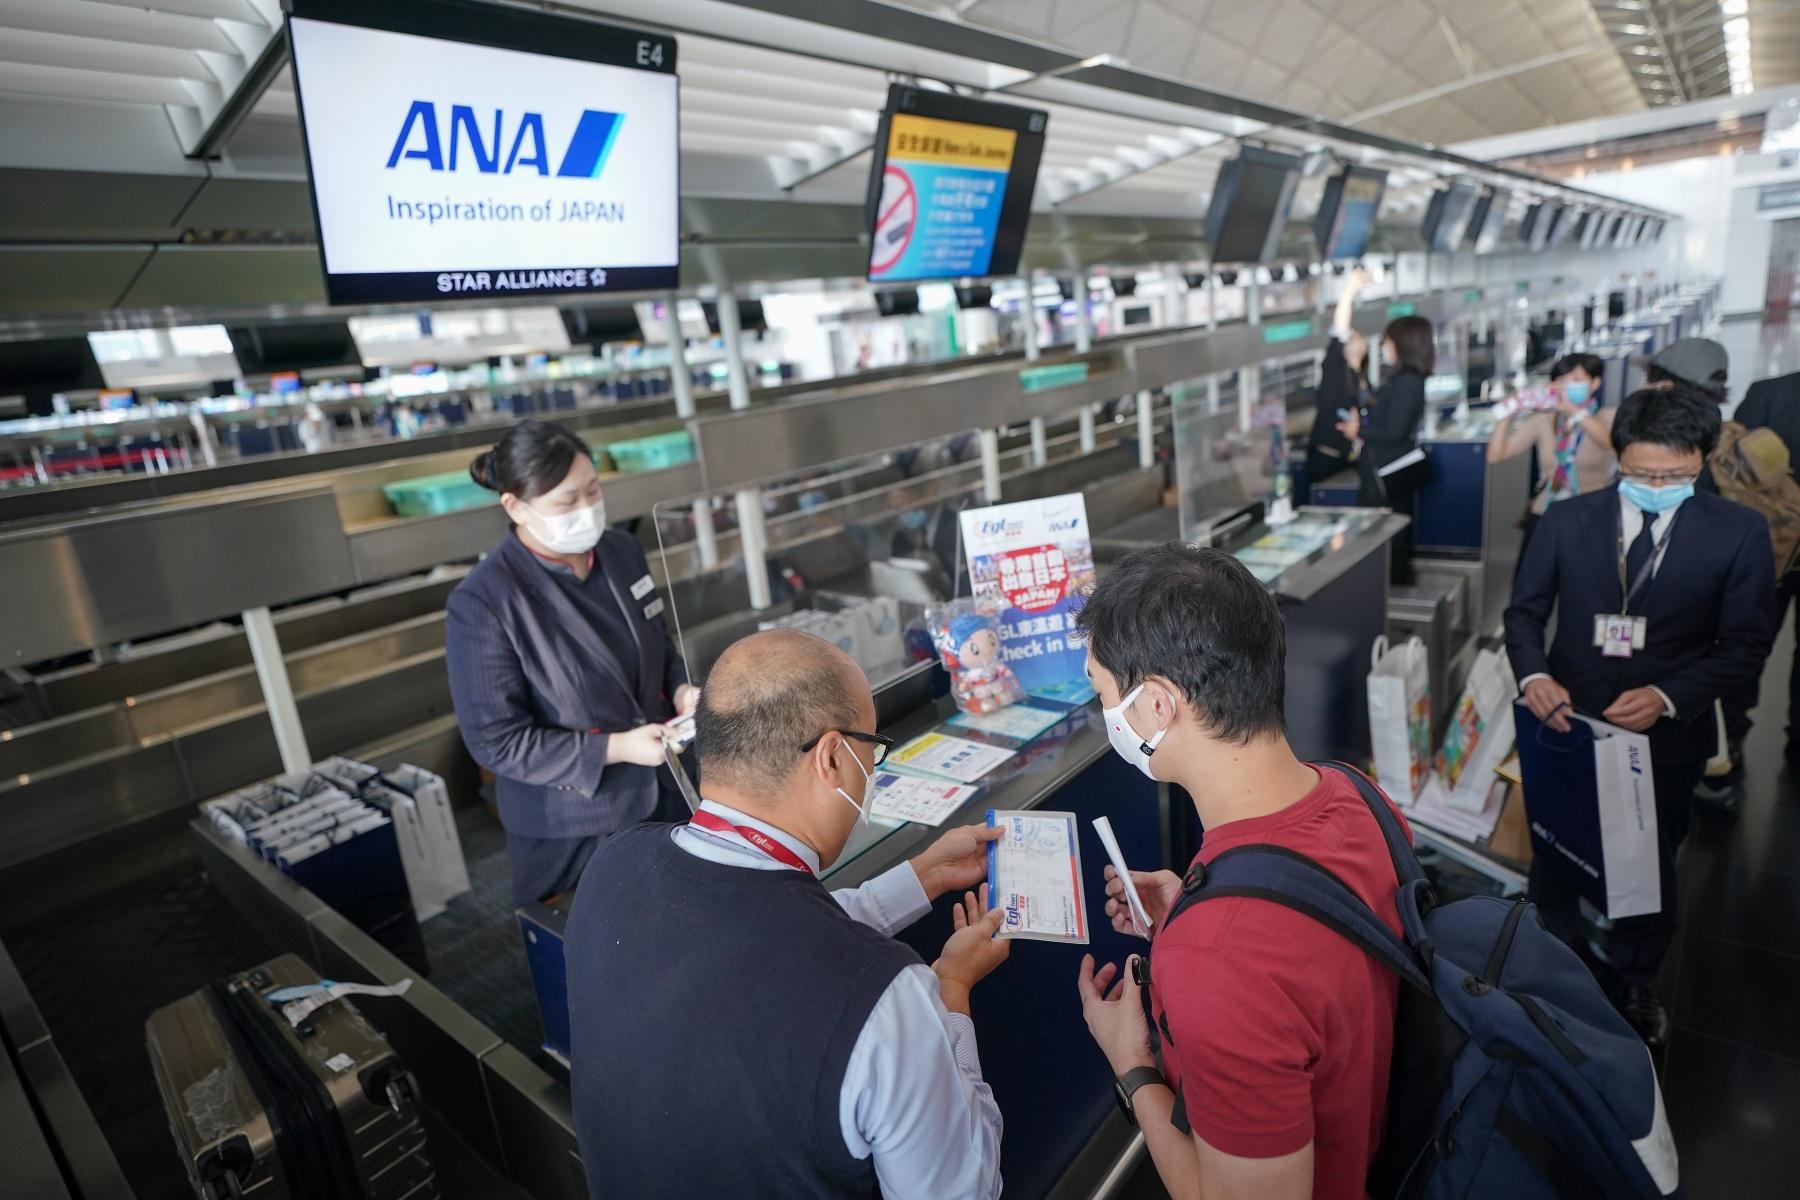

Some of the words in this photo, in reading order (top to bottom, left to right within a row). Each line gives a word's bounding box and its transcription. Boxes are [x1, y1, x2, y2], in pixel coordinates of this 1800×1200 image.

[636, 40, 664, 67] E4
[385, 100, 549, 177] ANA
[387, 194, 524, 225] Inspiration
[531, 198, 553, 222] of
[558, 200, 625, 222] JAPAN
[436, 272, 492, 292] STAR
[495, 269, 588, 290] ALLIANCE
[1045, 636, 1064, 653] in
